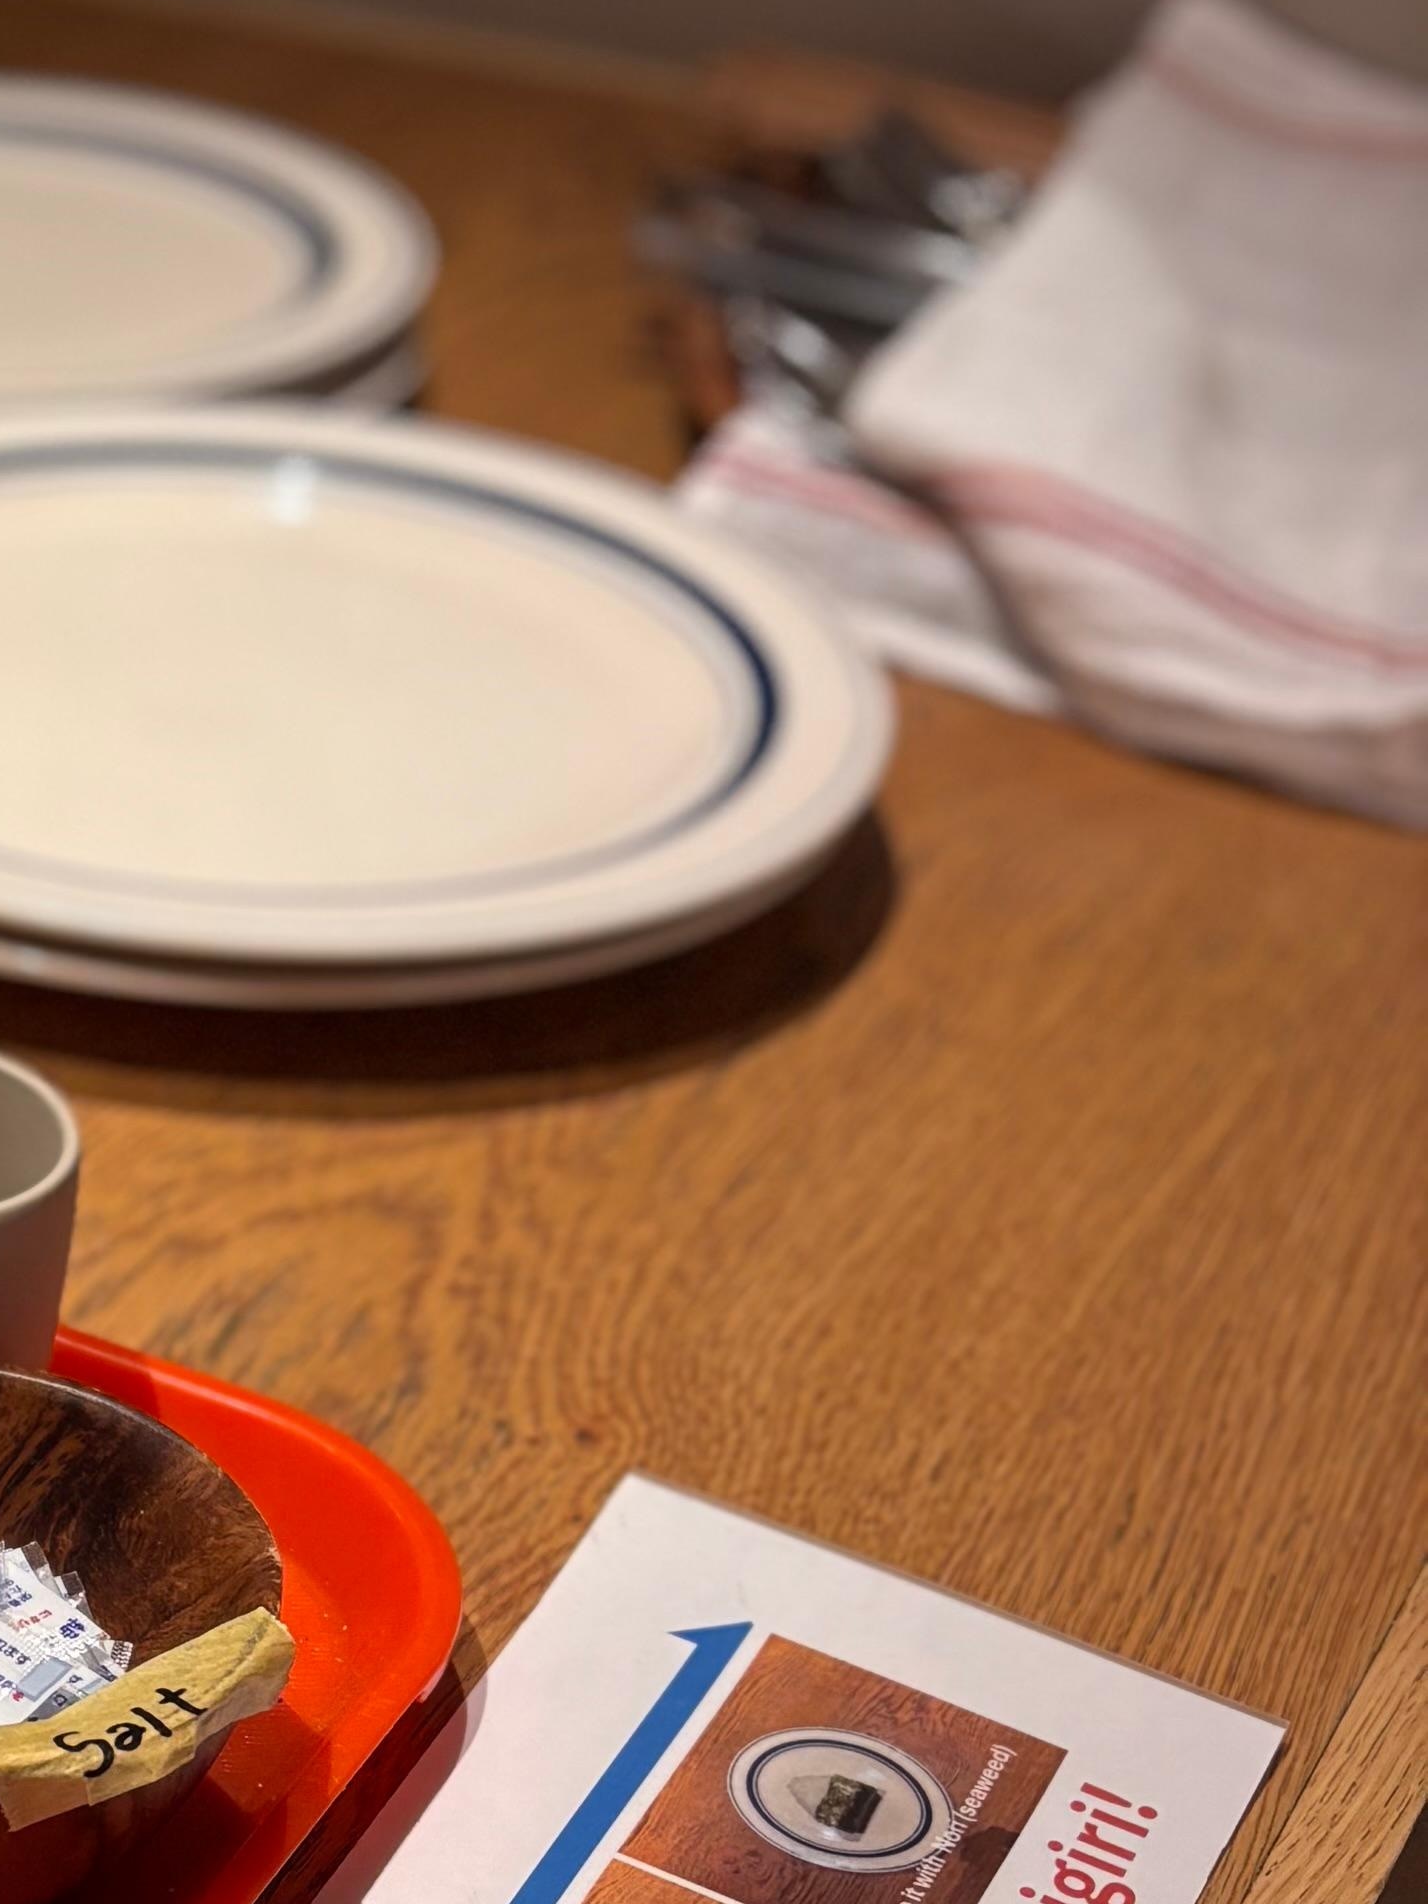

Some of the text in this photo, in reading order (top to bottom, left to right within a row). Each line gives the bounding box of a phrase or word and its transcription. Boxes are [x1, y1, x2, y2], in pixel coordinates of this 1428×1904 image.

[52, 1687, 208, 1778] Salt
[957, 1743, 1018, 1824] (seaweed)
[901, 1887, 926, 1903] it
[913, 1852, 948, 1889] with
